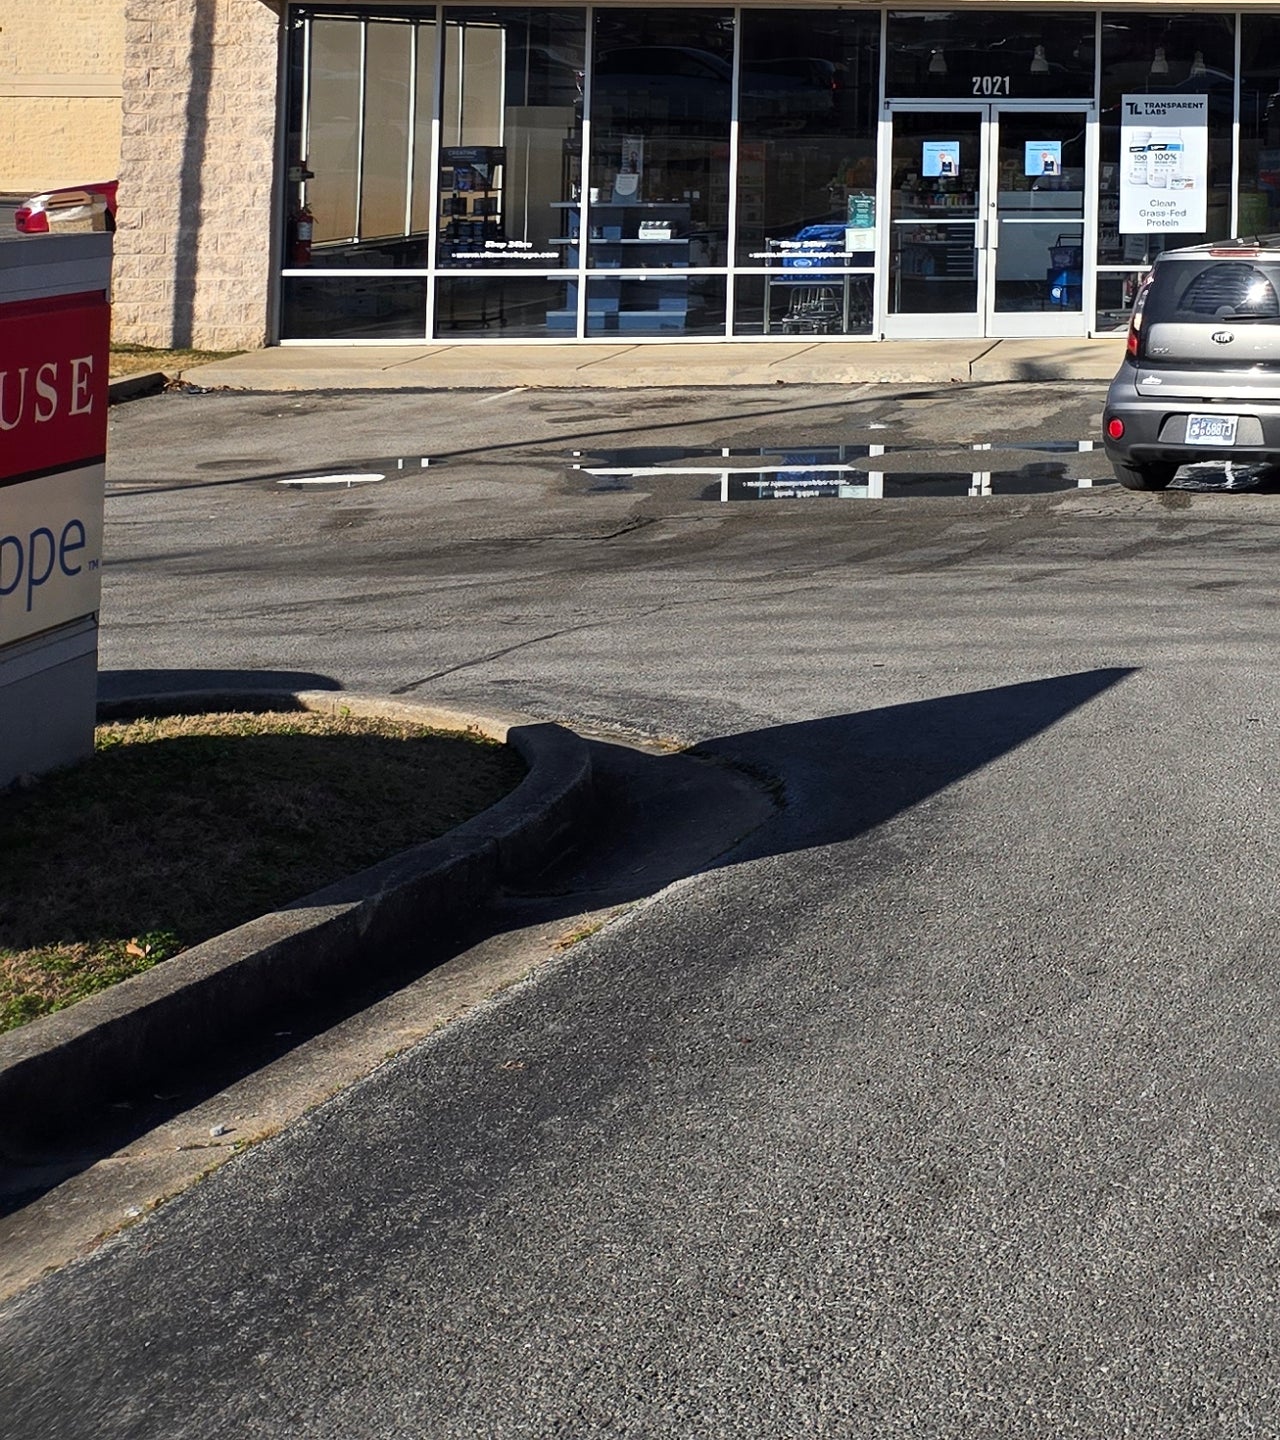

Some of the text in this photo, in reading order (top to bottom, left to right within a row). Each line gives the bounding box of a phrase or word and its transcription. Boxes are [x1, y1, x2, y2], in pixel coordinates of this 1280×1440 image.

[972, 76, 1010, 95] 2021
[1149, 199, 1176, 207] Clean
[1139, 209, 1187, 217] Grass-Fed
[1146, 219, 1179, 227] Protein
[1213, 332, 1233, 343] KIA
